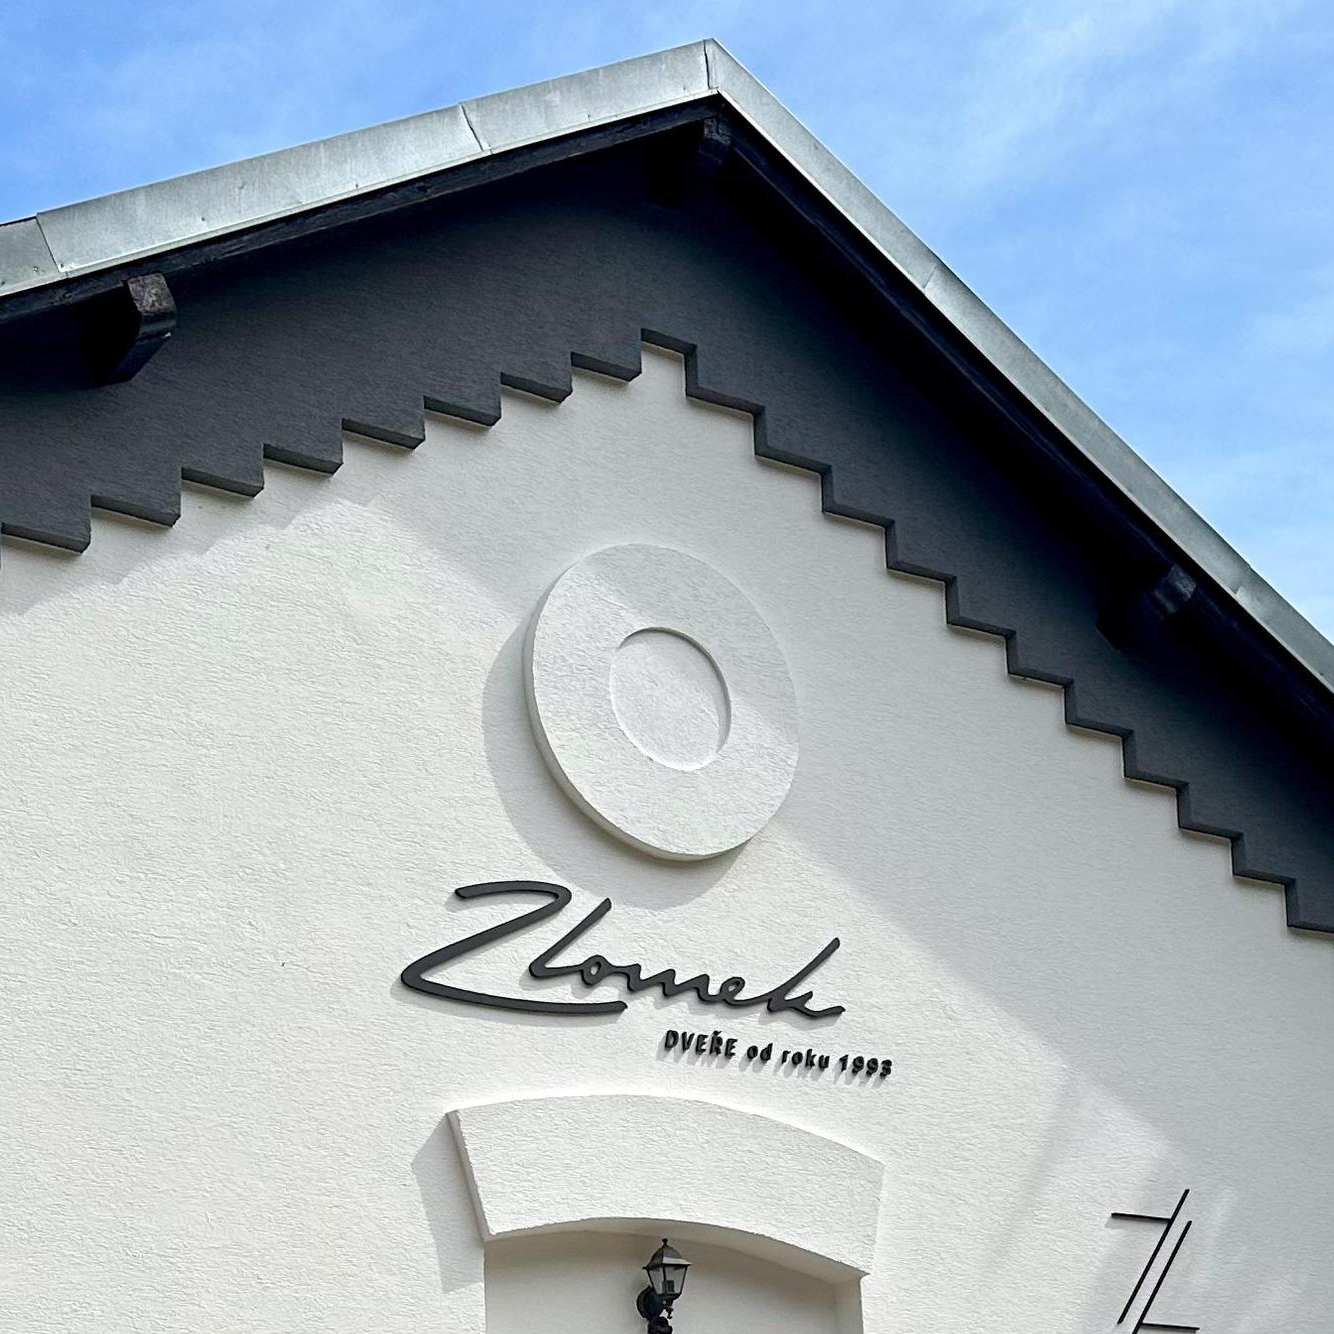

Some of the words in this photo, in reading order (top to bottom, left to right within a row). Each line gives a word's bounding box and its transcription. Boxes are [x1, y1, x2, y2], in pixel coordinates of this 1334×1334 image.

[400, 880, 846, 1019] Zlomek
[664, 1029, 738, 1059] DVEŘE
[746, 1043, 773, 1064] od
[781, 1048, 830, 1071] roku
[838, 1054, 893, 1079] 1993
